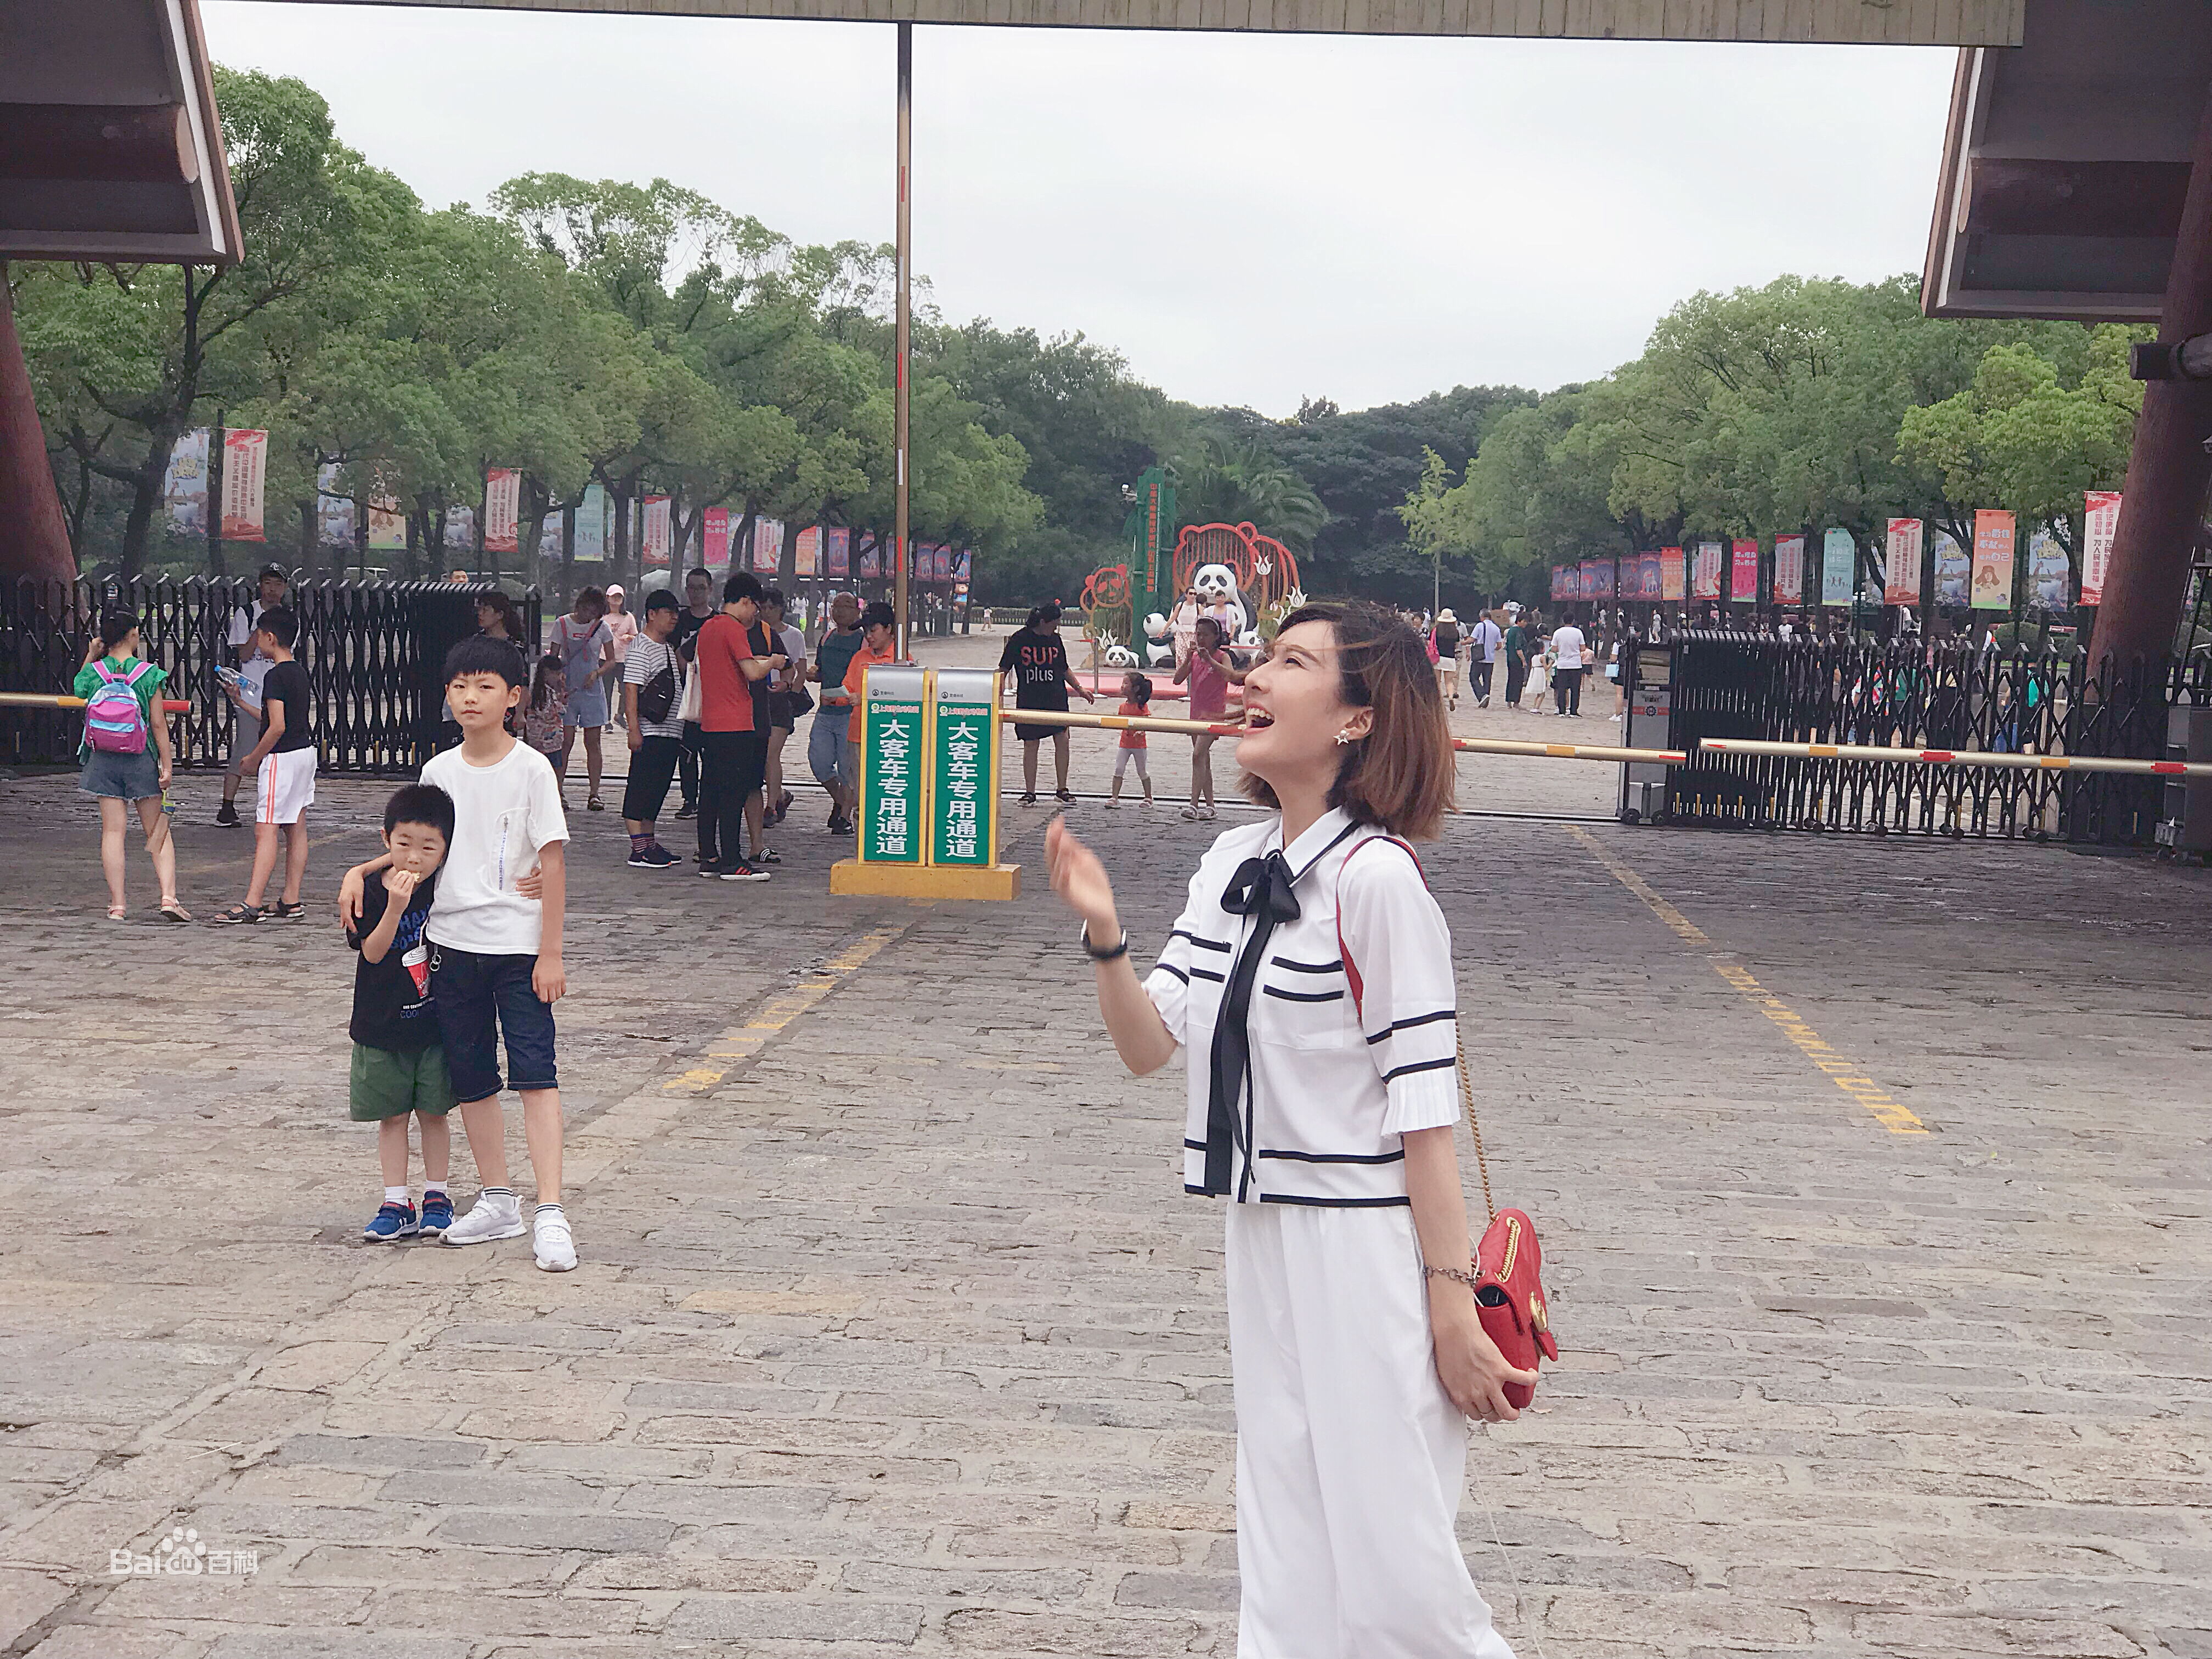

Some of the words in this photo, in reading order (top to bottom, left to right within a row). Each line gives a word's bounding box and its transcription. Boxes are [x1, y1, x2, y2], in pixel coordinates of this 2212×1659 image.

[1020, 646, 1058, 666] SUP
[876, 719, 910, 855] 大客车专用通道
[946, 721, 979, 857] 大客车专用通道
